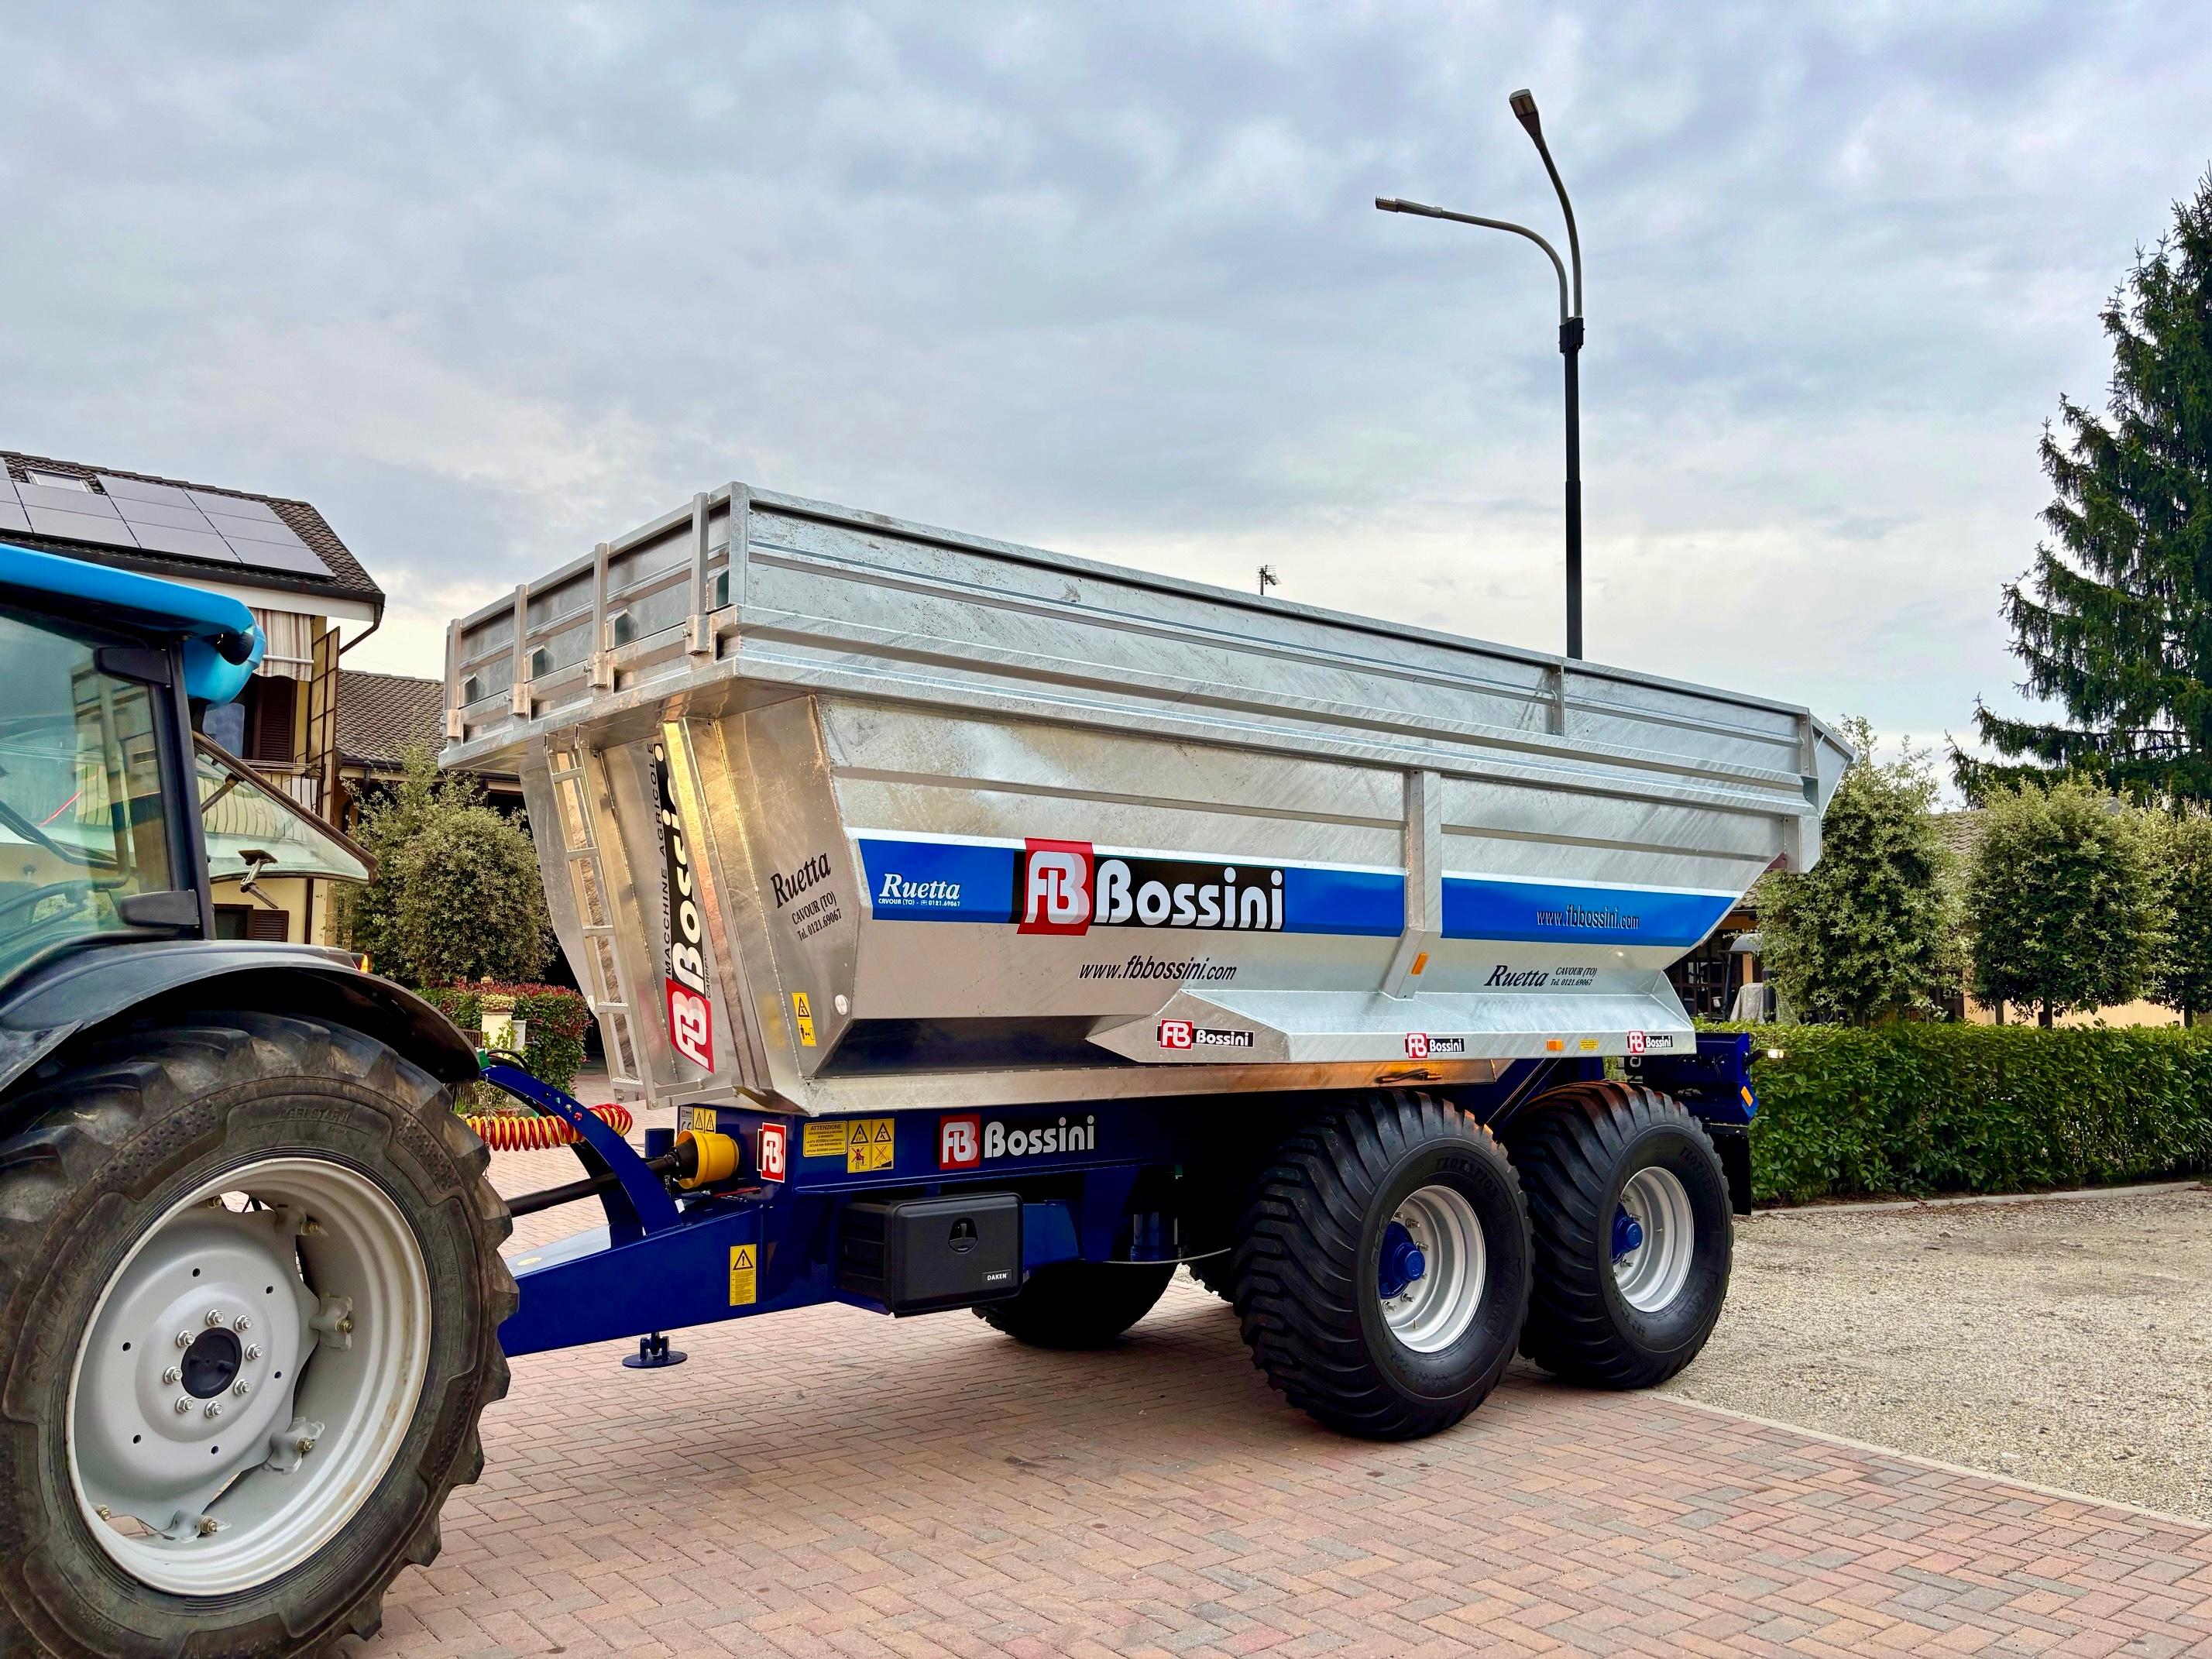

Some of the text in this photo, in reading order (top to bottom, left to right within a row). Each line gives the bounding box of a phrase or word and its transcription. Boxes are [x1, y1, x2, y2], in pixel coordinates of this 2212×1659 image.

[647, 743, 672, 976] MACCHINE AGRICOLE
[770, 852, 831, 909] Ruetta
[878, 873, 960, 900] Ruetta
[1094, 859, 1284, 929] Bossini
[792, 891, 837, 925] CAVOUR (TO)
[1537, 904, 1640, 929] www.fbbossini.com
[796, 908, 842, 941] Tel. 0121.69067
[1078, 955, 1238, 981] www.fbbossini.com
[1483, 964, 1549, 987] Ruetta
[1555, 967, 1598, 977] CAVOUR (TO)
[1196, 1029, 1249, 1046] Bossini
[1429, 1039, 1462, 1052] Bossini
[1645, 1036, 1671, 1047] Bossini
[984, 1115, 1094, 1159] Bossini
[987, 1273, 1007, 1281] DAKEN
